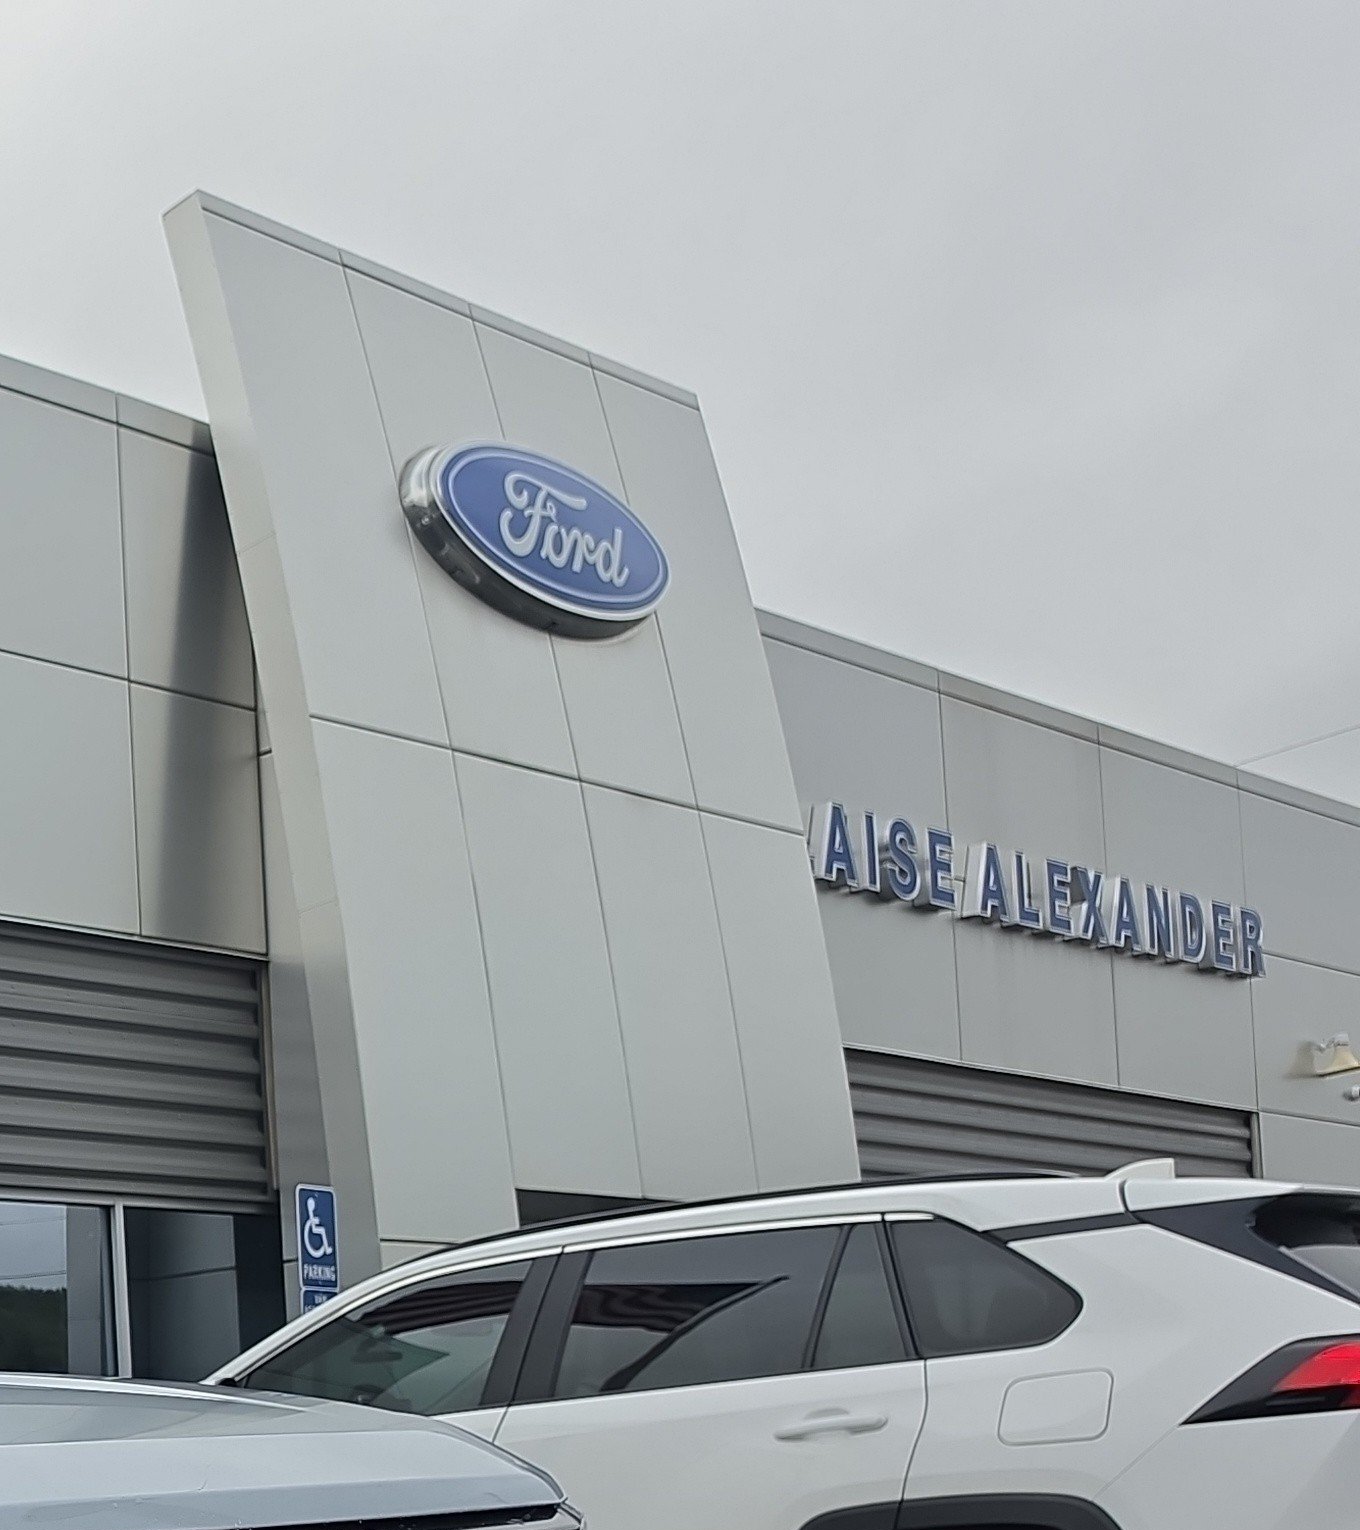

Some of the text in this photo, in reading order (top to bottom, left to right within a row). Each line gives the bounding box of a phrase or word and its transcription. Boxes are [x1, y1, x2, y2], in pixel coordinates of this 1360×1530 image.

[498, 470, 630, 588] Ford
[810, 800, 1267, 978] AISE ALEXANDER
[303, 1263, 336, 1282] PARKING
